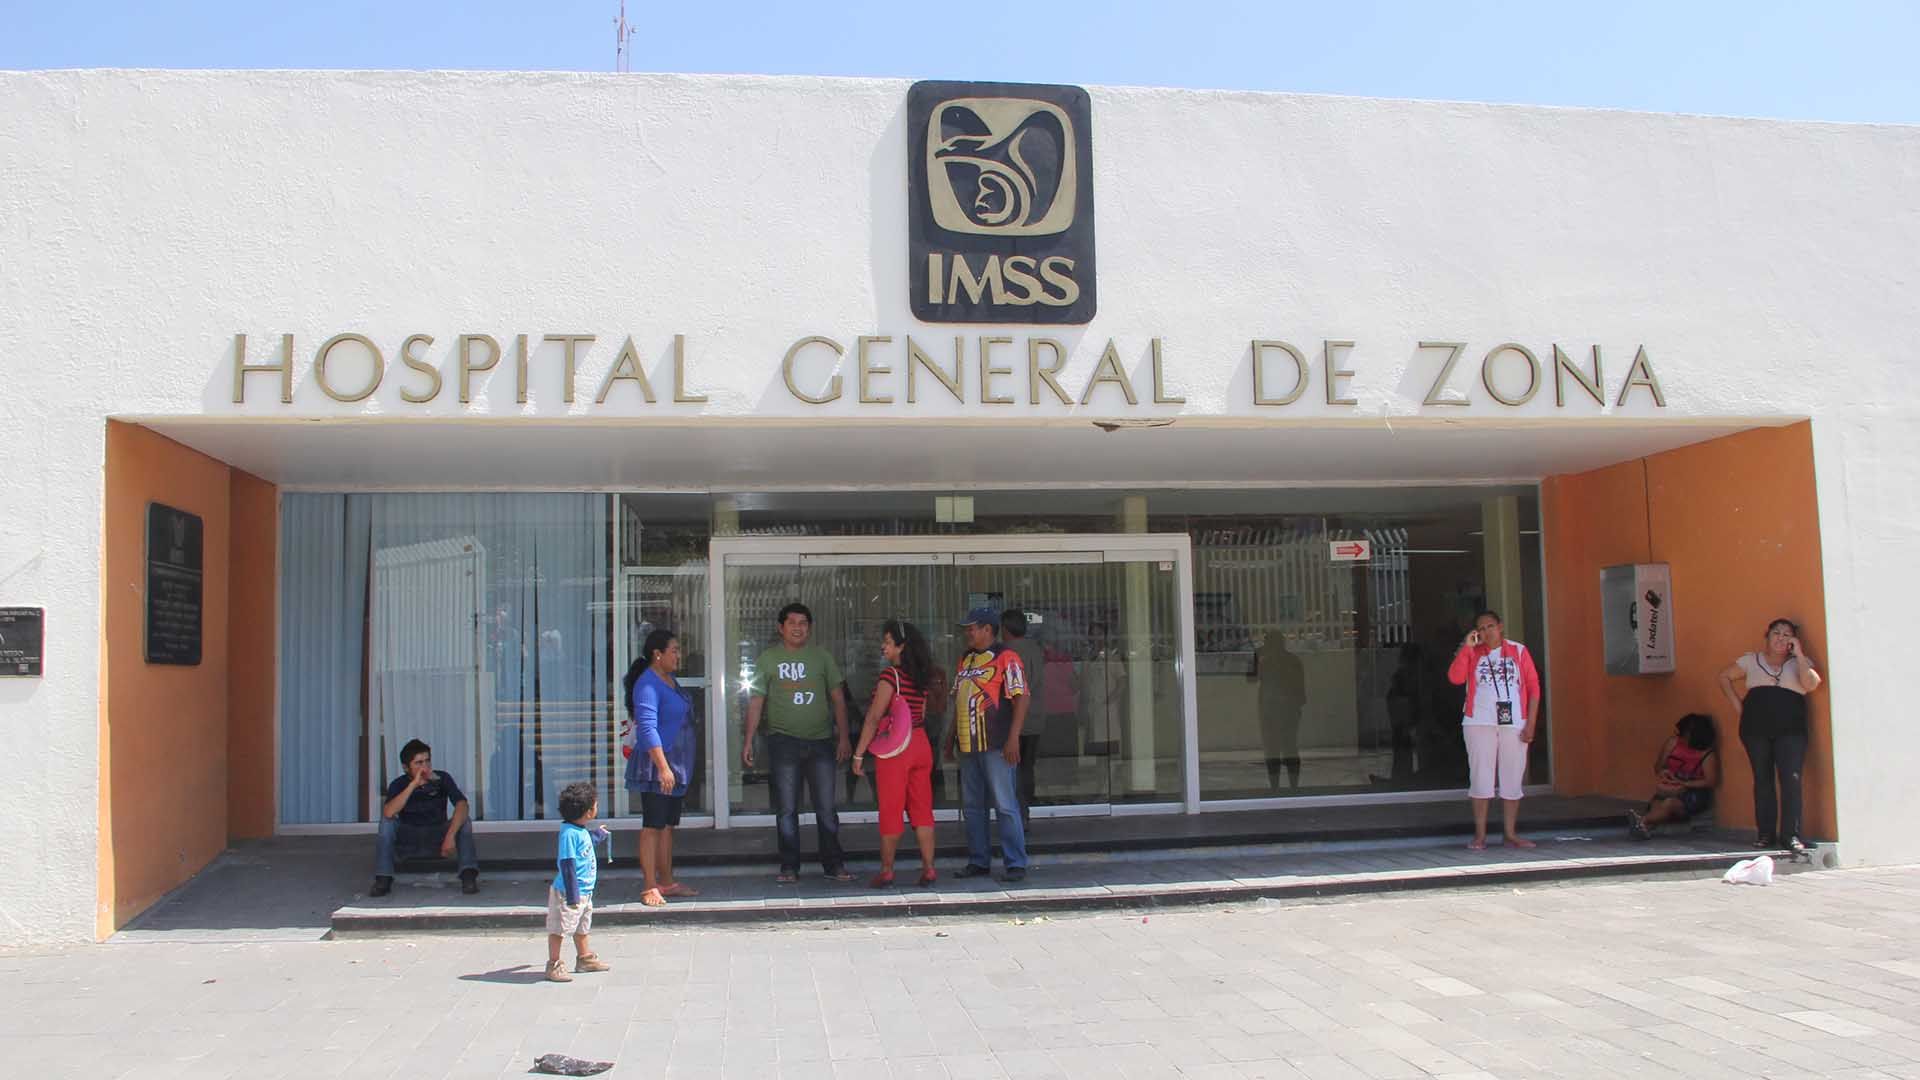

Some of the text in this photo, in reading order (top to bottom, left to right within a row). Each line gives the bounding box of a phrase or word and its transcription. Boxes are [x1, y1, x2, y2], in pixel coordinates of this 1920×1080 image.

[929, 252, 1080, 306] IMSS
[232, 332, 1667, 408] HOSPITAL GENERAL DE ZONA
[1647, 609, 1658, 649] Ladatel
[793, 691, 815, 705] 87
